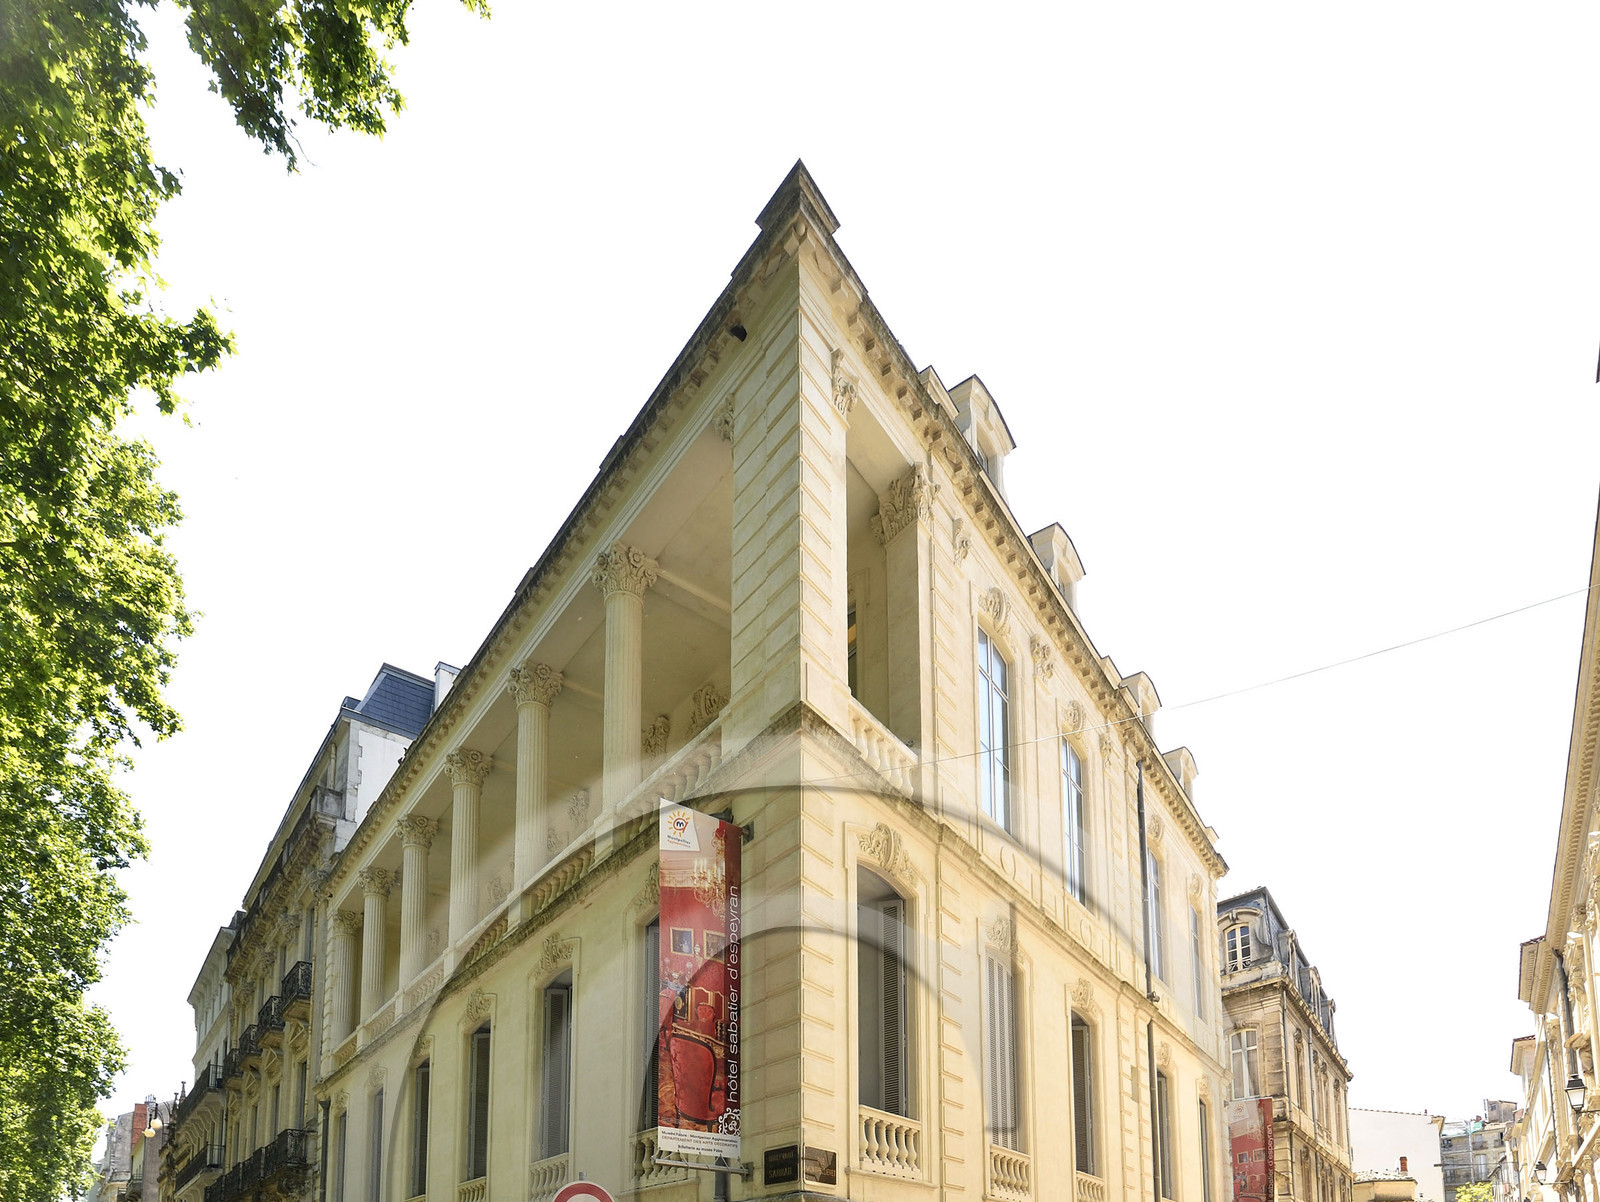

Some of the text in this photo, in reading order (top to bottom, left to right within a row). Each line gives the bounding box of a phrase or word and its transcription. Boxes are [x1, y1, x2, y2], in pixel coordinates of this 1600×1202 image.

[727, 885, 740, 1102] hôtel sabatier d'espeyran
